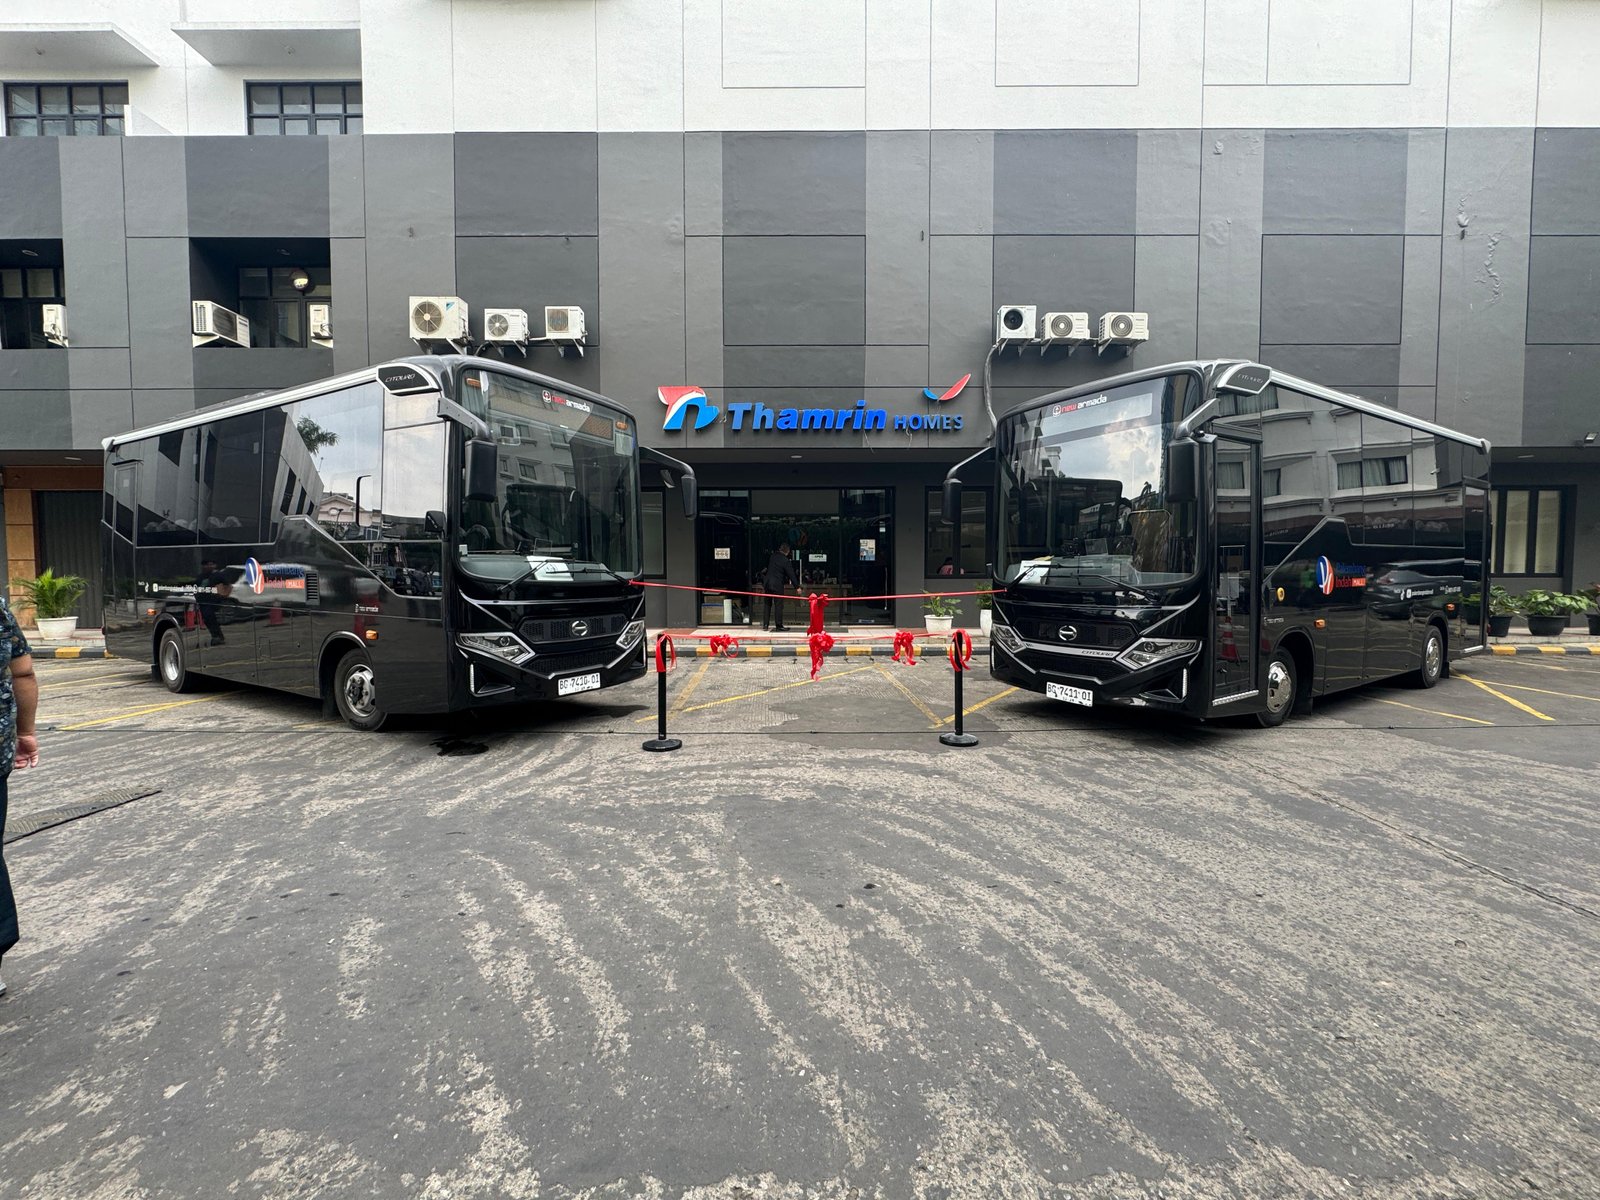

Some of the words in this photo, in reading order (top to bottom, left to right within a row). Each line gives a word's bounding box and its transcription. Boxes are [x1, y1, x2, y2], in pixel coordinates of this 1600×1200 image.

[566, 400, 591, 412] armada
[1061, 403, 1077, 413] new
[1077, 394, 1107, 409] armada
[727, 399, 888, 431] Thamrin
[893, 414, 964, 431] HOMES
[559, 679, 568, 690] BG
[1047, 683, 1057, 694] BG
[1059, 686, 1078, 699] 7411
